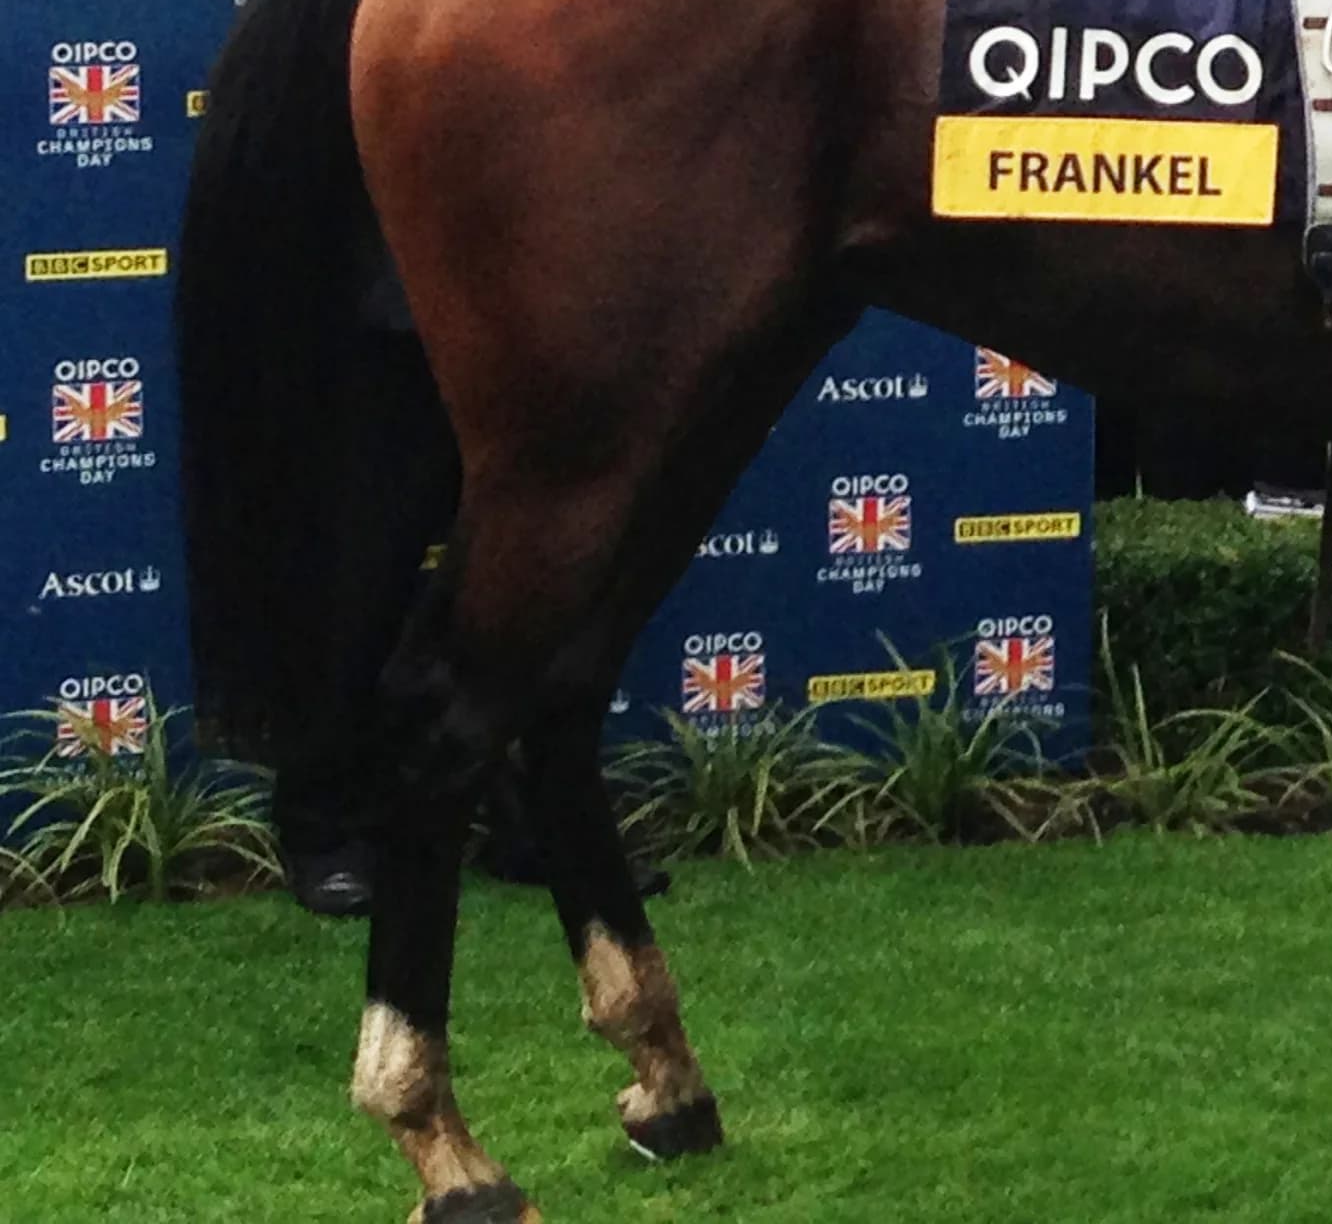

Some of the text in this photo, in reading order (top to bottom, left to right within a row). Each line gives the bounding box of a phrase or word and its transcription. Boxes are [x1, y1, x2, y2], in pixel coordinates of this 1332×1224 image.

[970, 28, 1262, 104] QIPCO
[37, 135, 152, 156] CHAMPIONS
[77, 153, 113, 167] DAY
[988, 150, 1222, 197] FRANKEL
[91, 254, 160, 273] SPORT
[818, 377, 903, 400] Ascot
[998, 425, 1030, 439] DAY
[40, 450, 155, 475] CHAMPIONS
[80, 469, 115, 485] DAY
[1012, 517, 1073, 535] SPORT
[699, 532, 755, 559] scot
[42, 572, 133, 596] Ascot
[818, 561, 921, 585] CHAMPIONS
[853, 578, 886, 594] DAY
